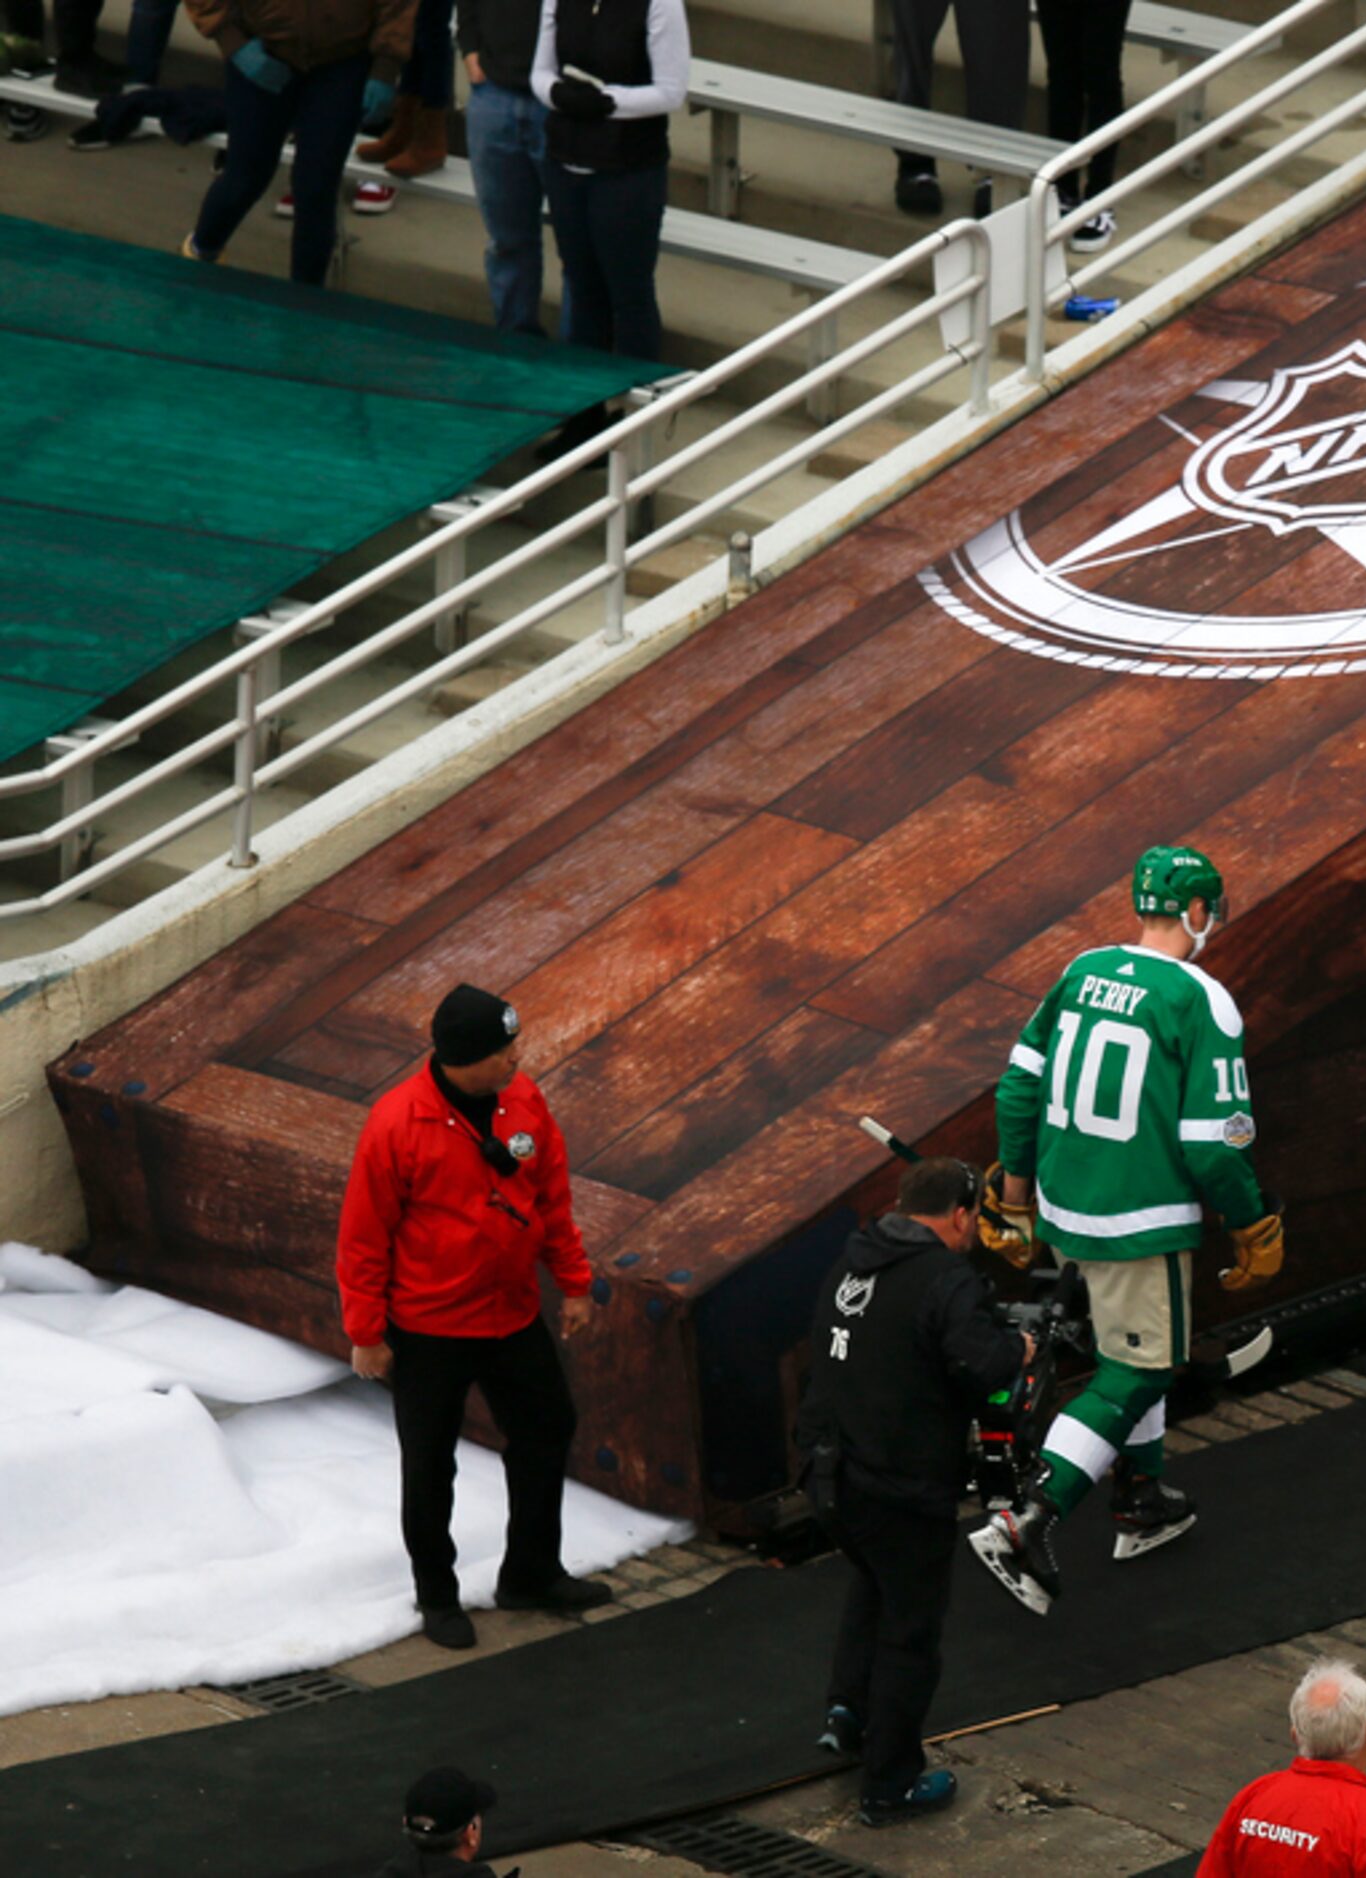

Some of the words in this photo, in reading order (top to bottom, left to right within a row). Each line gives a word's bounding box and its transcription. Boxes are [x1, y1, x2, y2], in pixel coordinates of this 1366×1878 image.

[1076, 974, 1148, 1016] PERRY
[1046, 1009, 1152, 1143] 10
[1212, 1057, 1251, 1102] 10
[829, 1325, 851, 1361] 76
[1239, 1816, 1321, 1853] SECURITY
